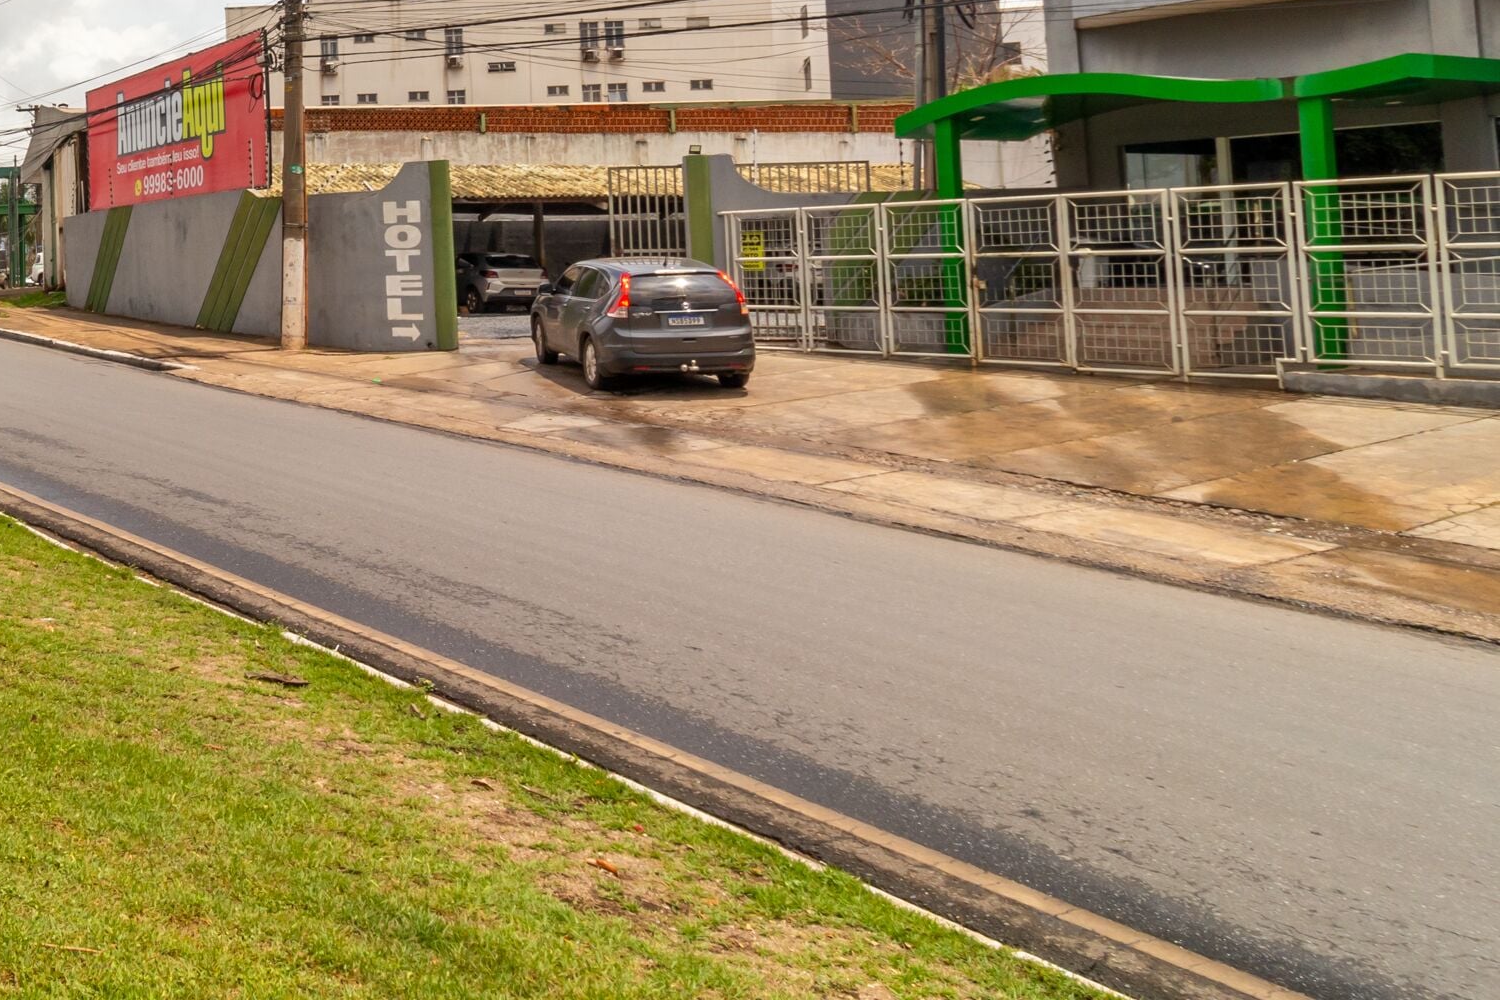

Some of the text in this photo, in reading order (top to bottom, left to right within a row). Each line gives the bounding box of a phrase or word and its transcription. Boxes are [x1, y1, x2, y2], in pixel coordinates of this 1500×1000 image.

[116, 162, 127, 175] Seu
[128, 159, 146, 172] cliente
[183, 145, 200, 160] isso!
[383, 200, 424, 321] HOTEL
